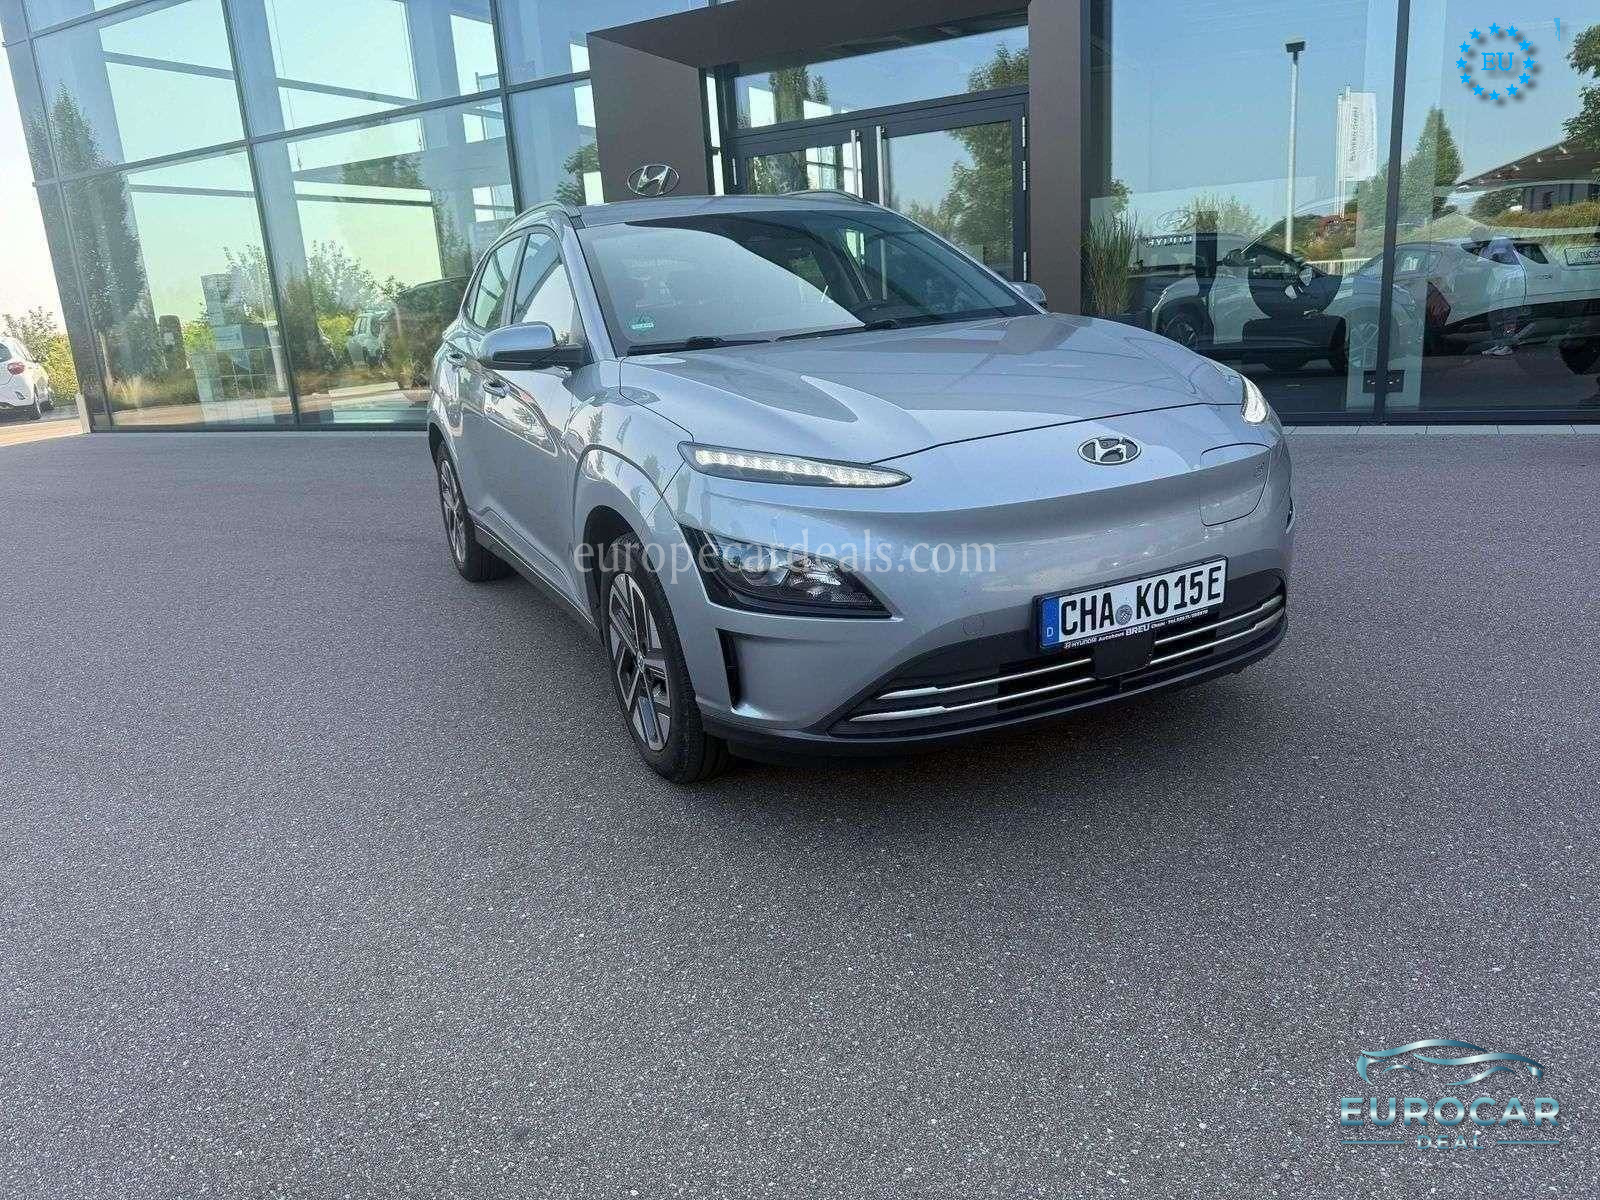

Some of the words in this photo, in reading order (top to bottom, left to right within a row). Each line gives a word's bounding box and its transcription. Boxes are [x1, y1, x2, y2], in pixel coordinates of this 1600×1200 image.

[1060, 592, 1115, 636] CHA
[1046, 626, 1054, 638] D
[1125, 624, 1150, 636] BREU
